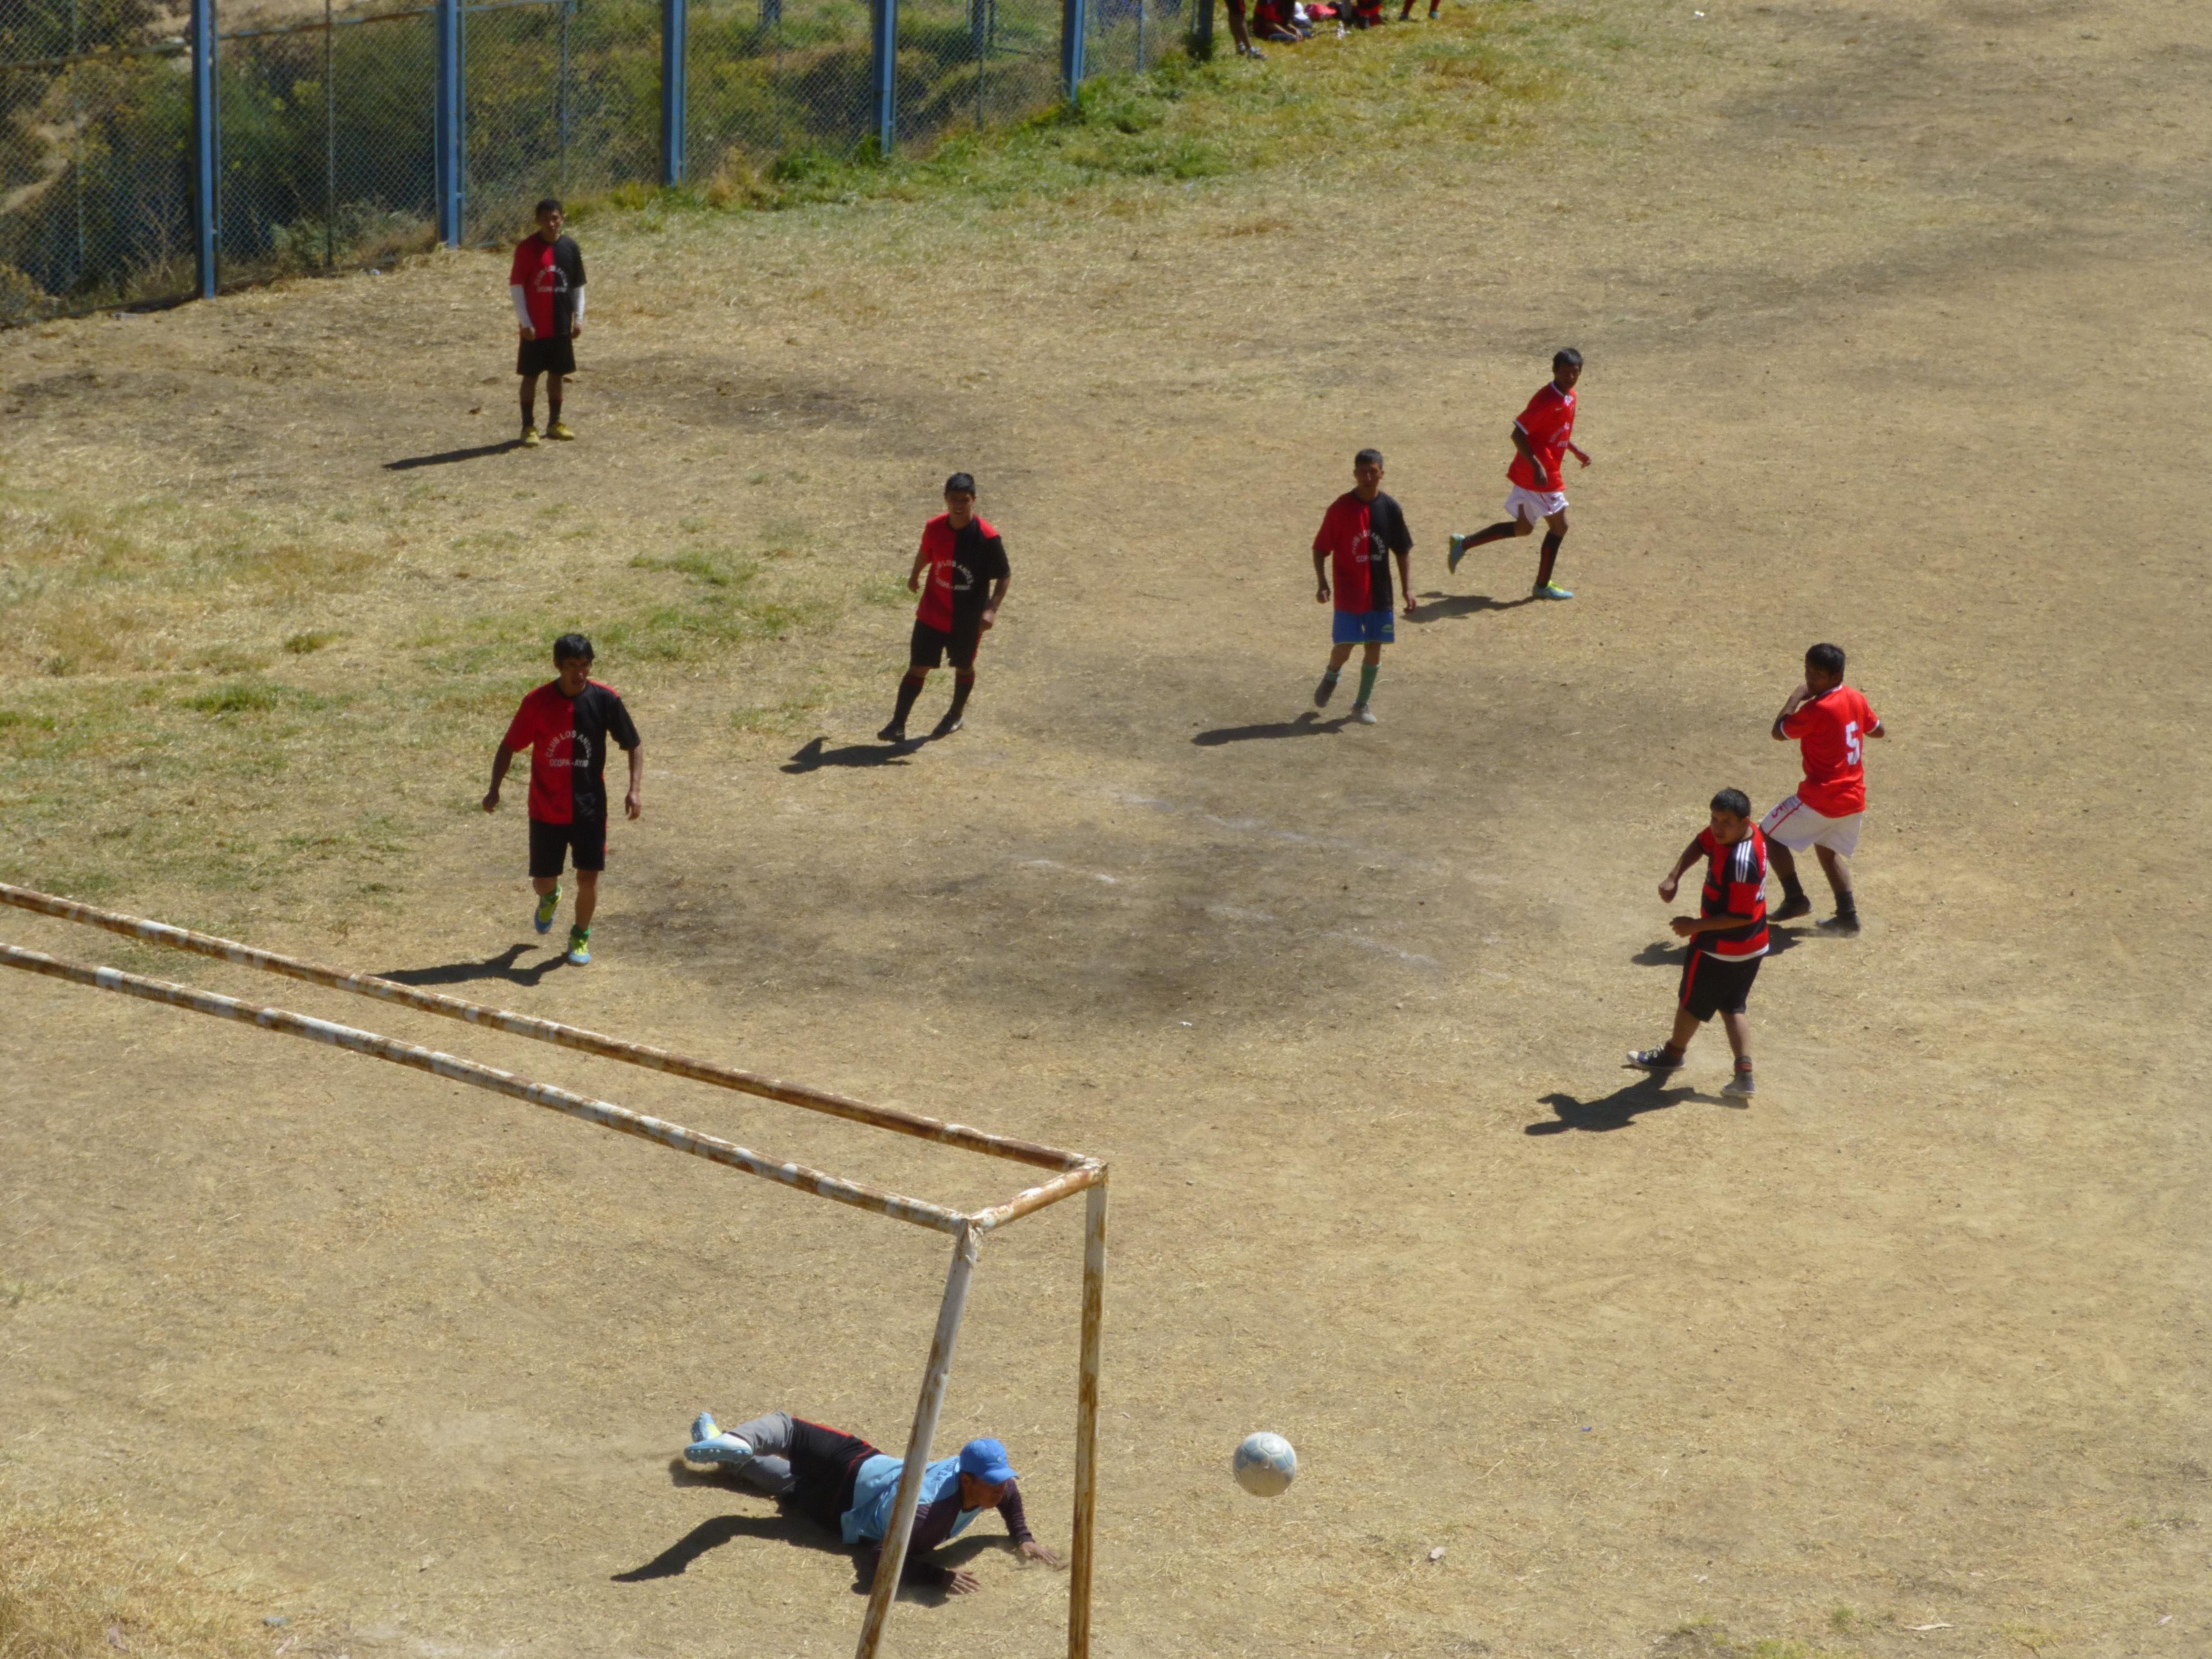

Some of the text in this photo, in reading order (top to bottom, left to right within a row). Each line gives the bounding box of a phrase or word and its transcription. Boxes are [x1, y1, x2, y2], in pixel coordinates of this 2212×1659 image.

[545, 737, 560, 757] CLUB
[559, 730, 577, 740] LOS
[1845, 721, 1860, 765] 5
